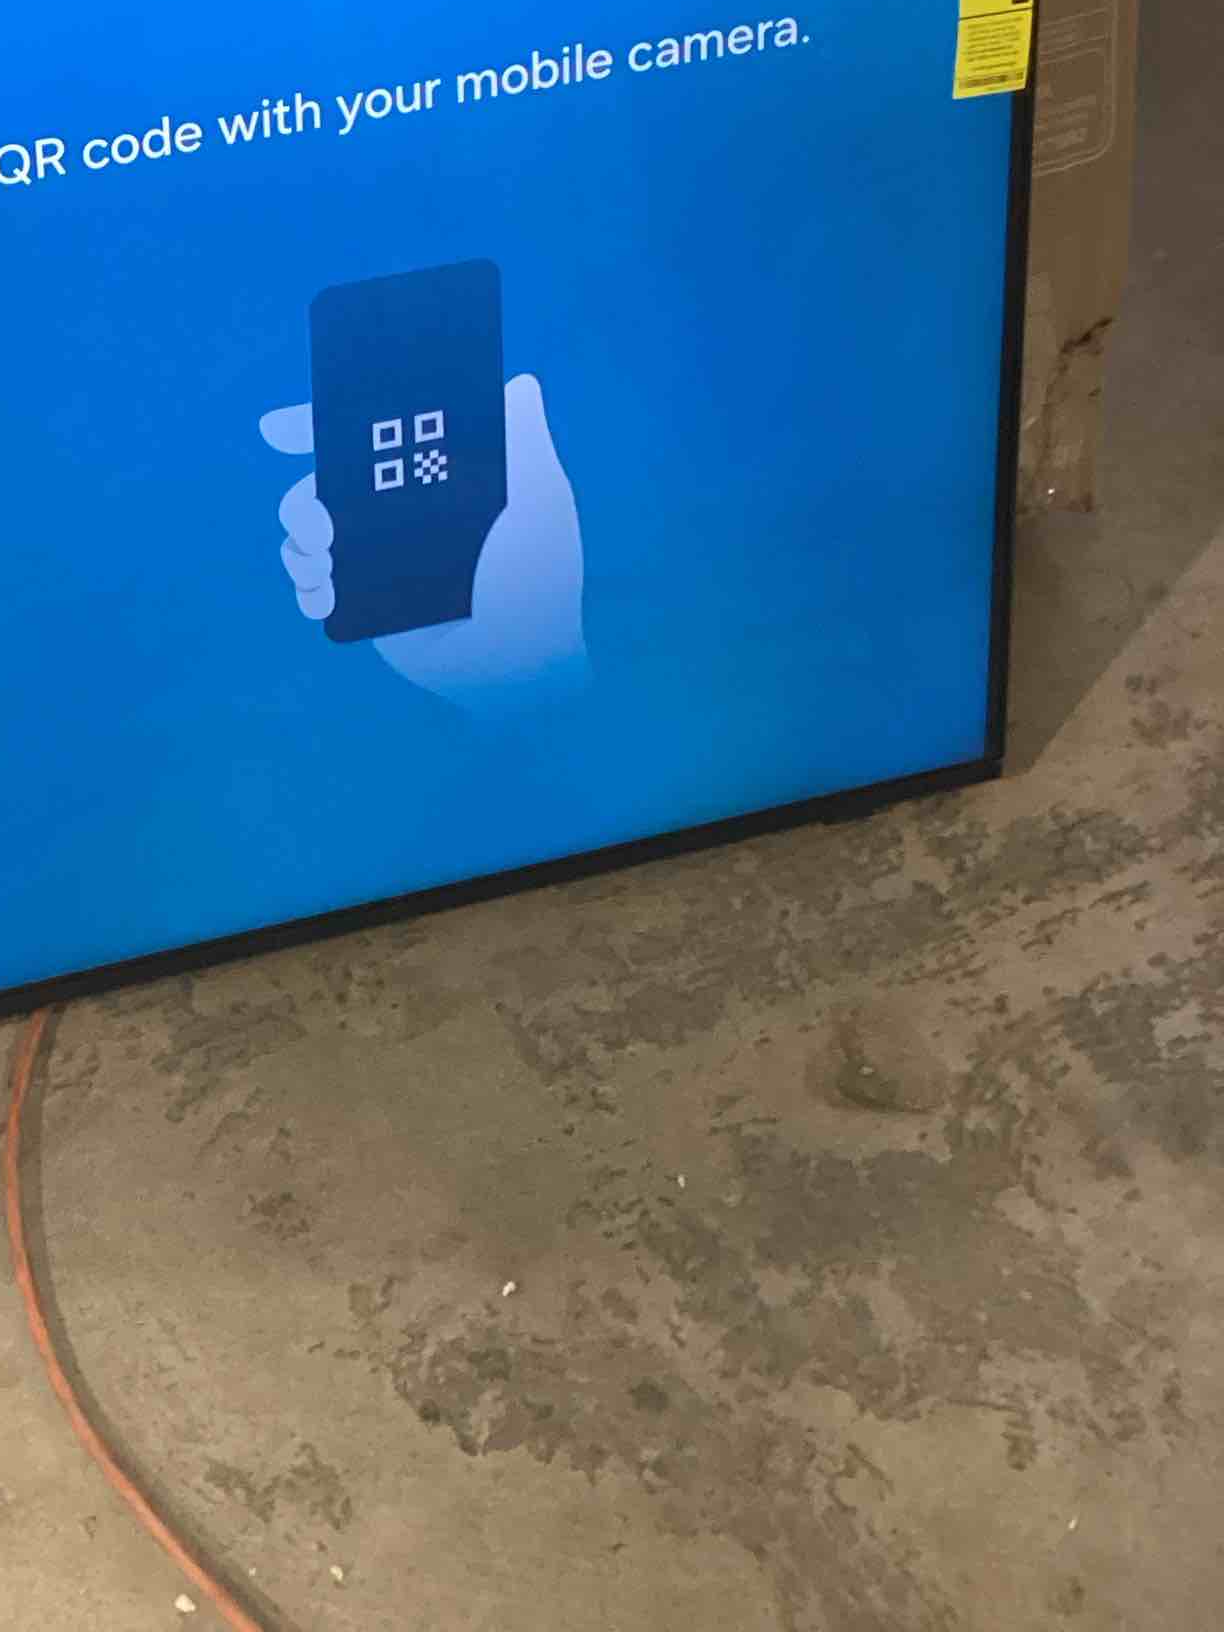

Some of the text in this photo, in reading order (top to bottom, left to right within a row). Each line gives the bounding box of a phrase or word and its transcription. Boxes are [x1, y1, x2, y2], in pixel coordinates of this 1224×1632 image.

[81, 114, 204, 170] code
[216, 91, 322, 146] with
[334, 77, 442, 136] your
[455, 42, 614, 104] mobile
[627, 16, 811, 73] camera.
